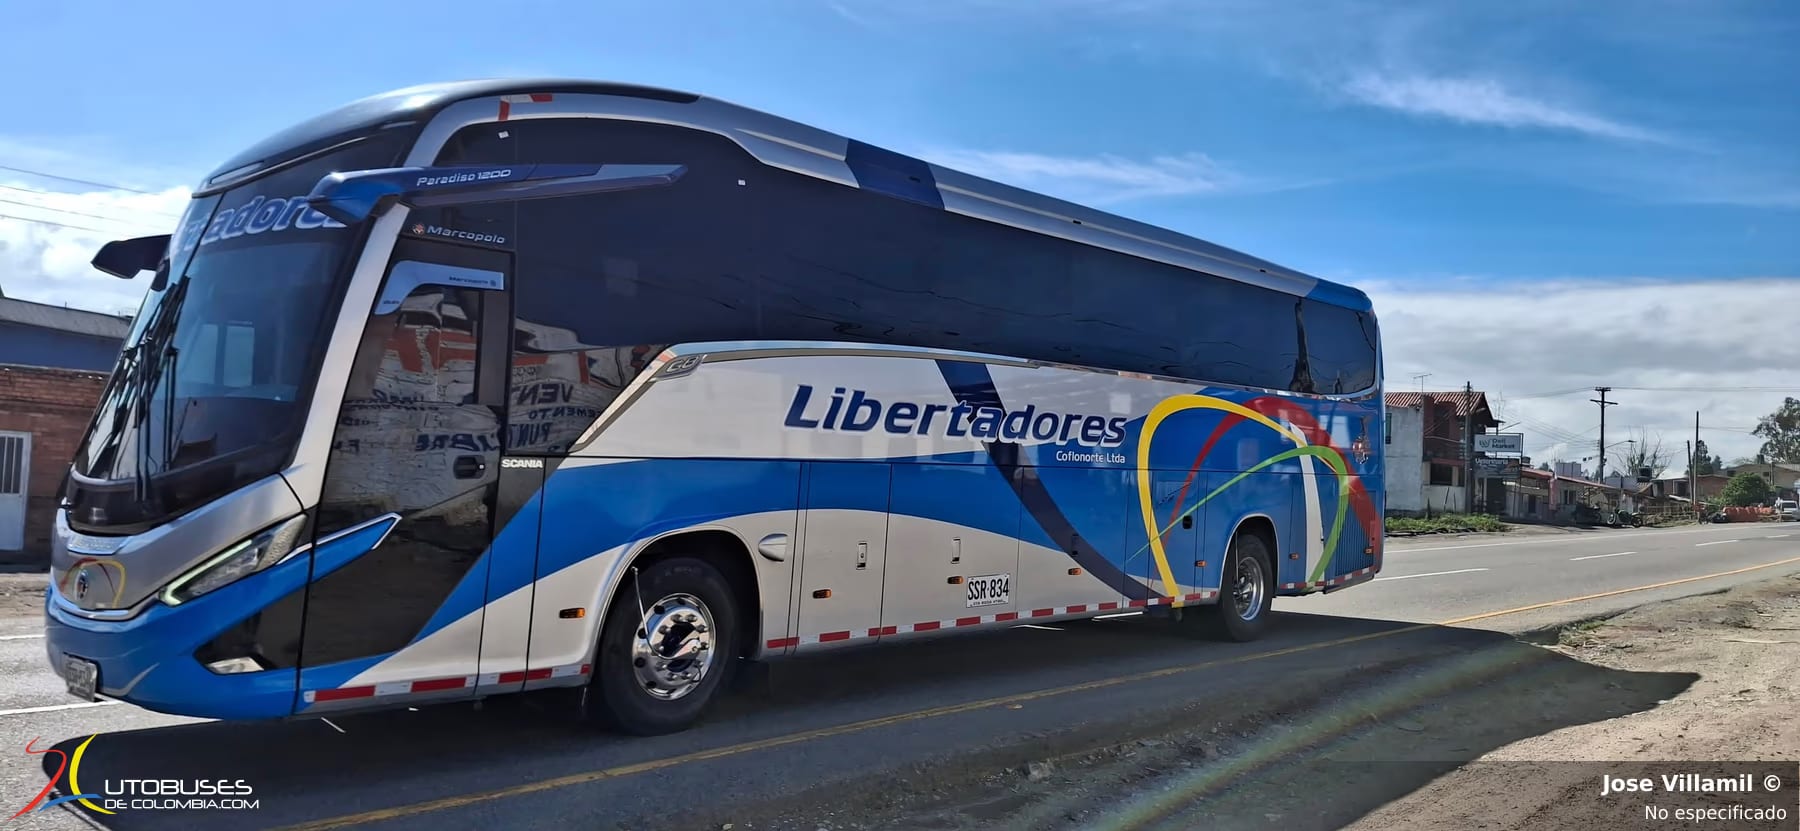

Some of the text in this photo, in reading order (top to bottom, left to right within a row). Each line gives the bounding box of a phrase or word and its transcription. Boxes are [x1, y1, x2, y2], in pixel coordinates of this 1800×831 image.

[416, 169, 512, 187] Paradiso 1200
[427, 225, 505, 244] Marcopolo
[783, 383, 1128, 447] Libertadores
[501, 458, 543, 469] SCANIA
[1106, 452, 1126, 464] Ltda
